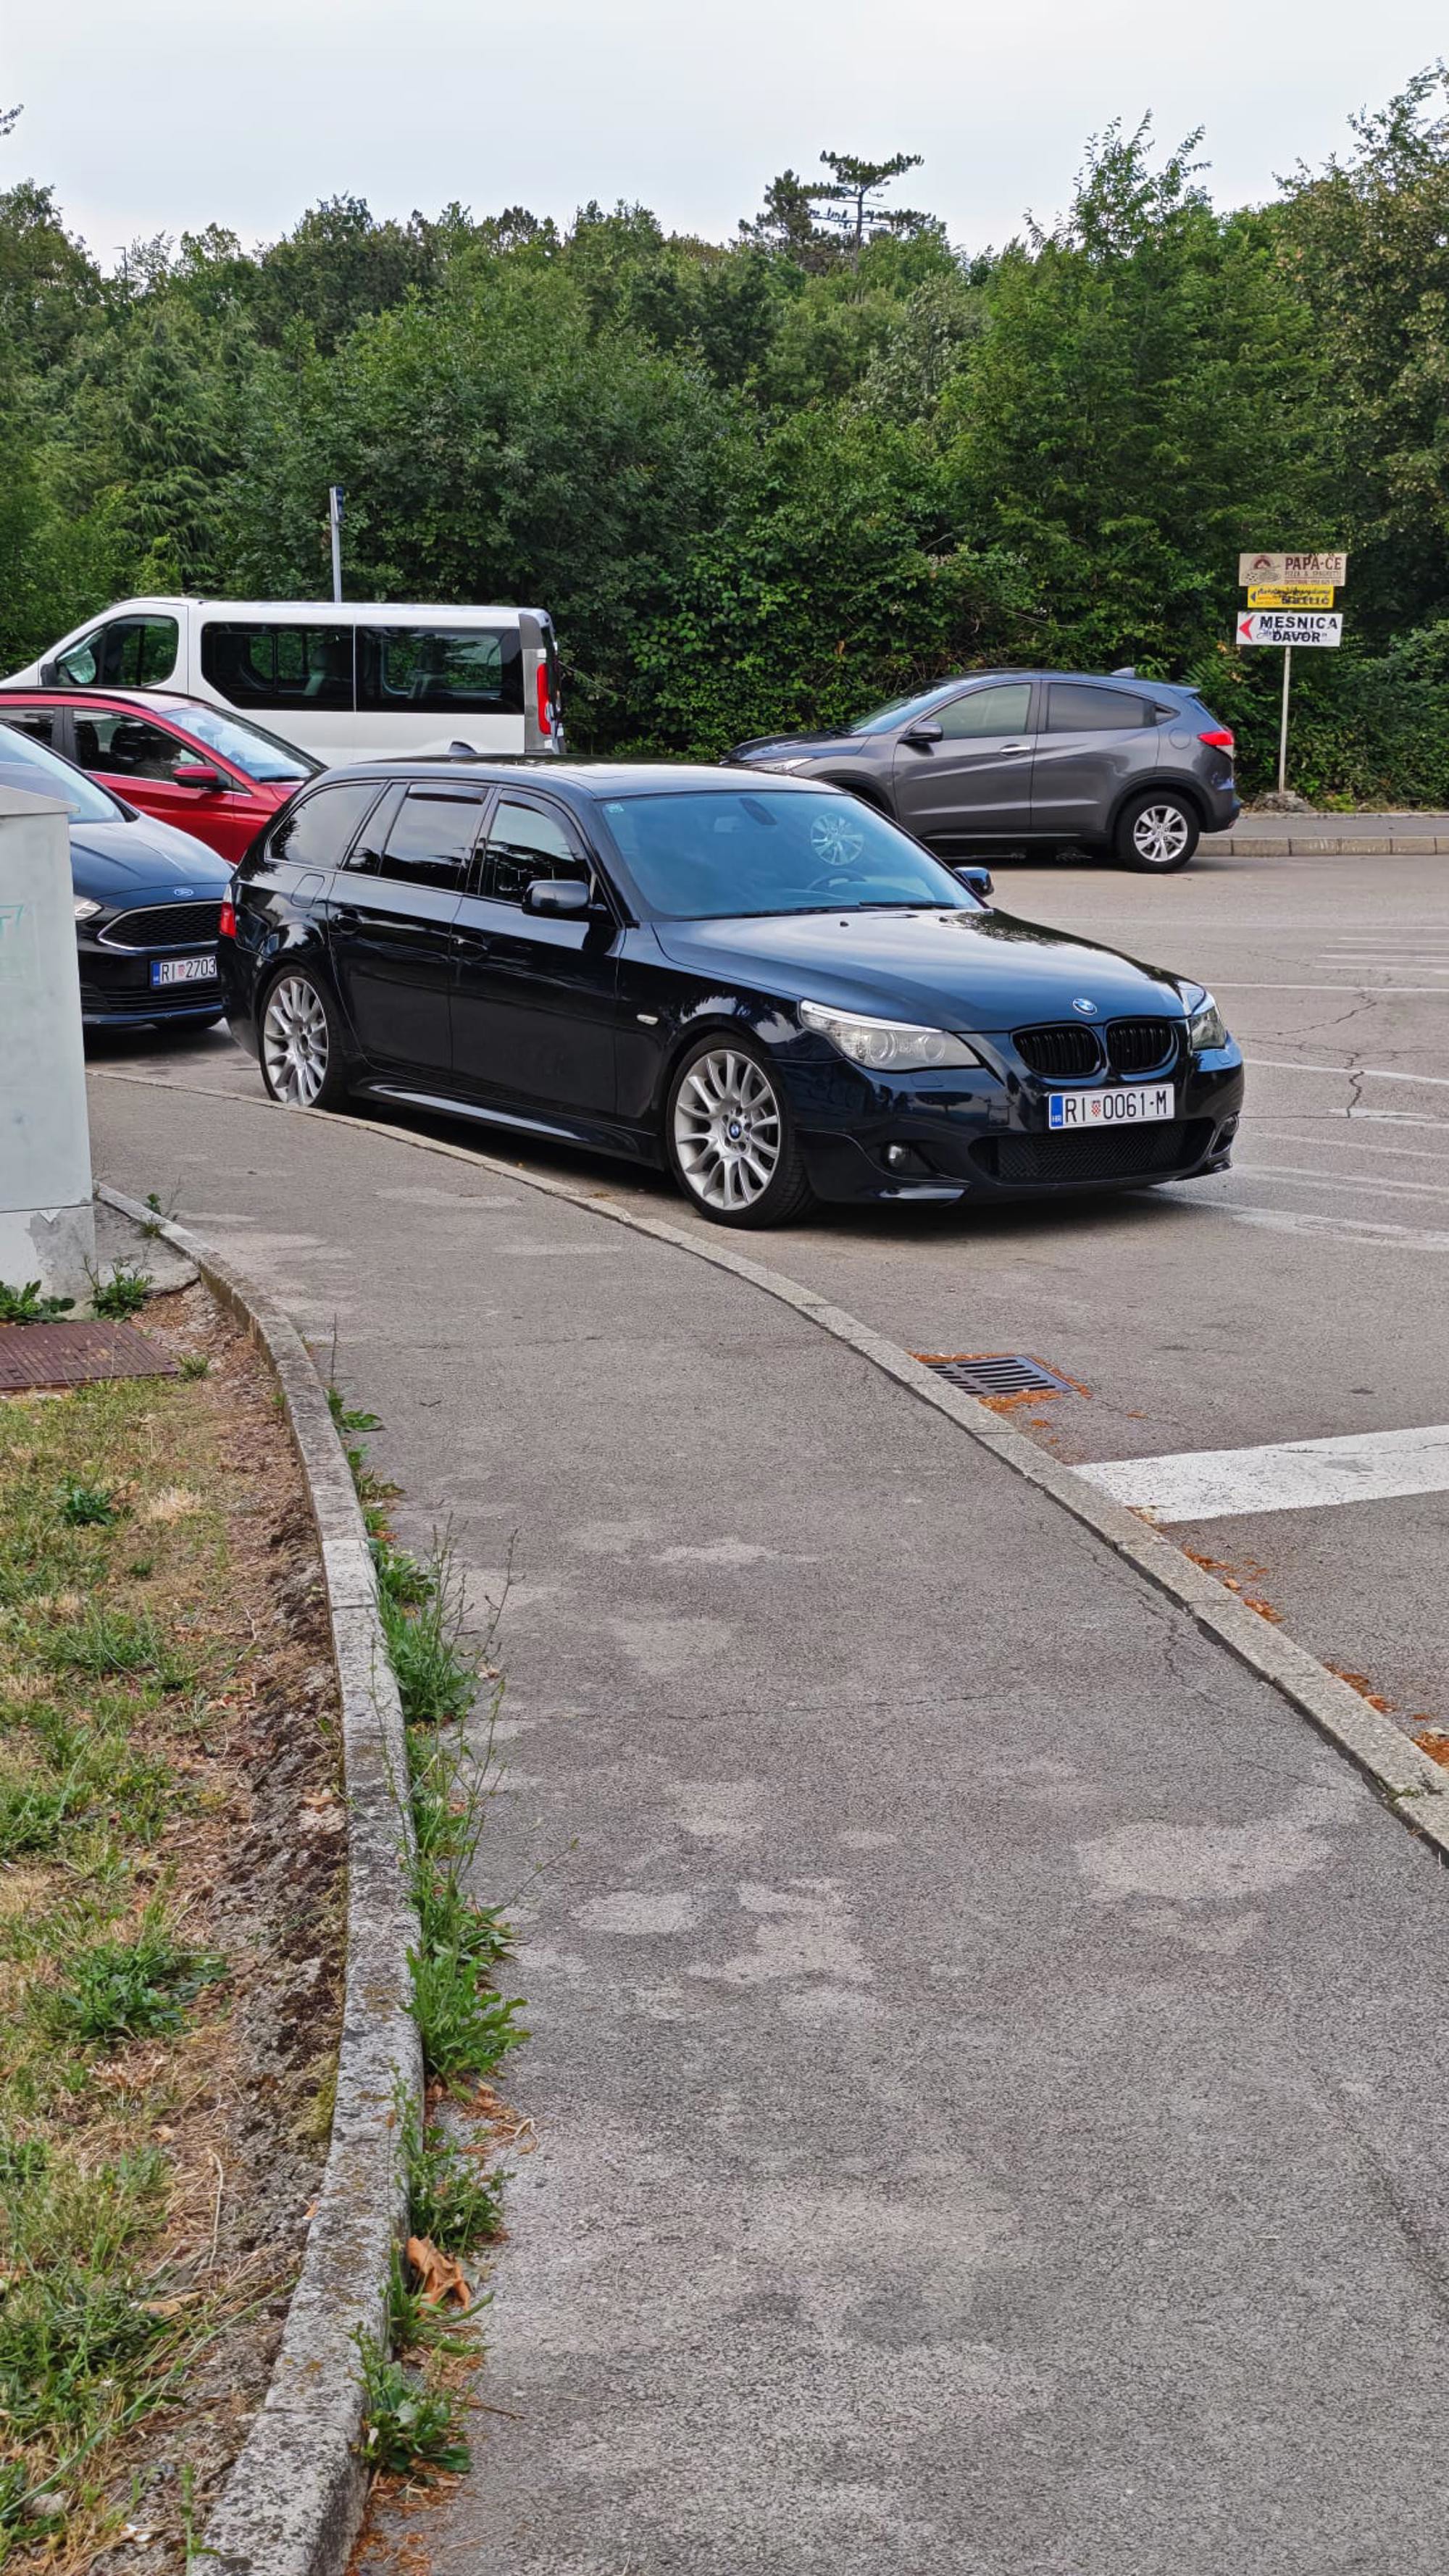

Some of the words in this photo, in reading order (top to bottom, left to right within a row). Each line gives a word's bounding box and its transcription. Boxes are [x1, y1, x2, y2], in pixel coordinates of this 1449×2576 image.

[1259, 616, 1337, 629] MESNICA
[1272, 630, 1321, 643] DAVOR
[162, 963, 175, 982] RI
[185, 958, 216, 978] 2703
[1065, 1097, 1085, 1122] RI
[1103, 1090, 1166, 1119] 0061-M
